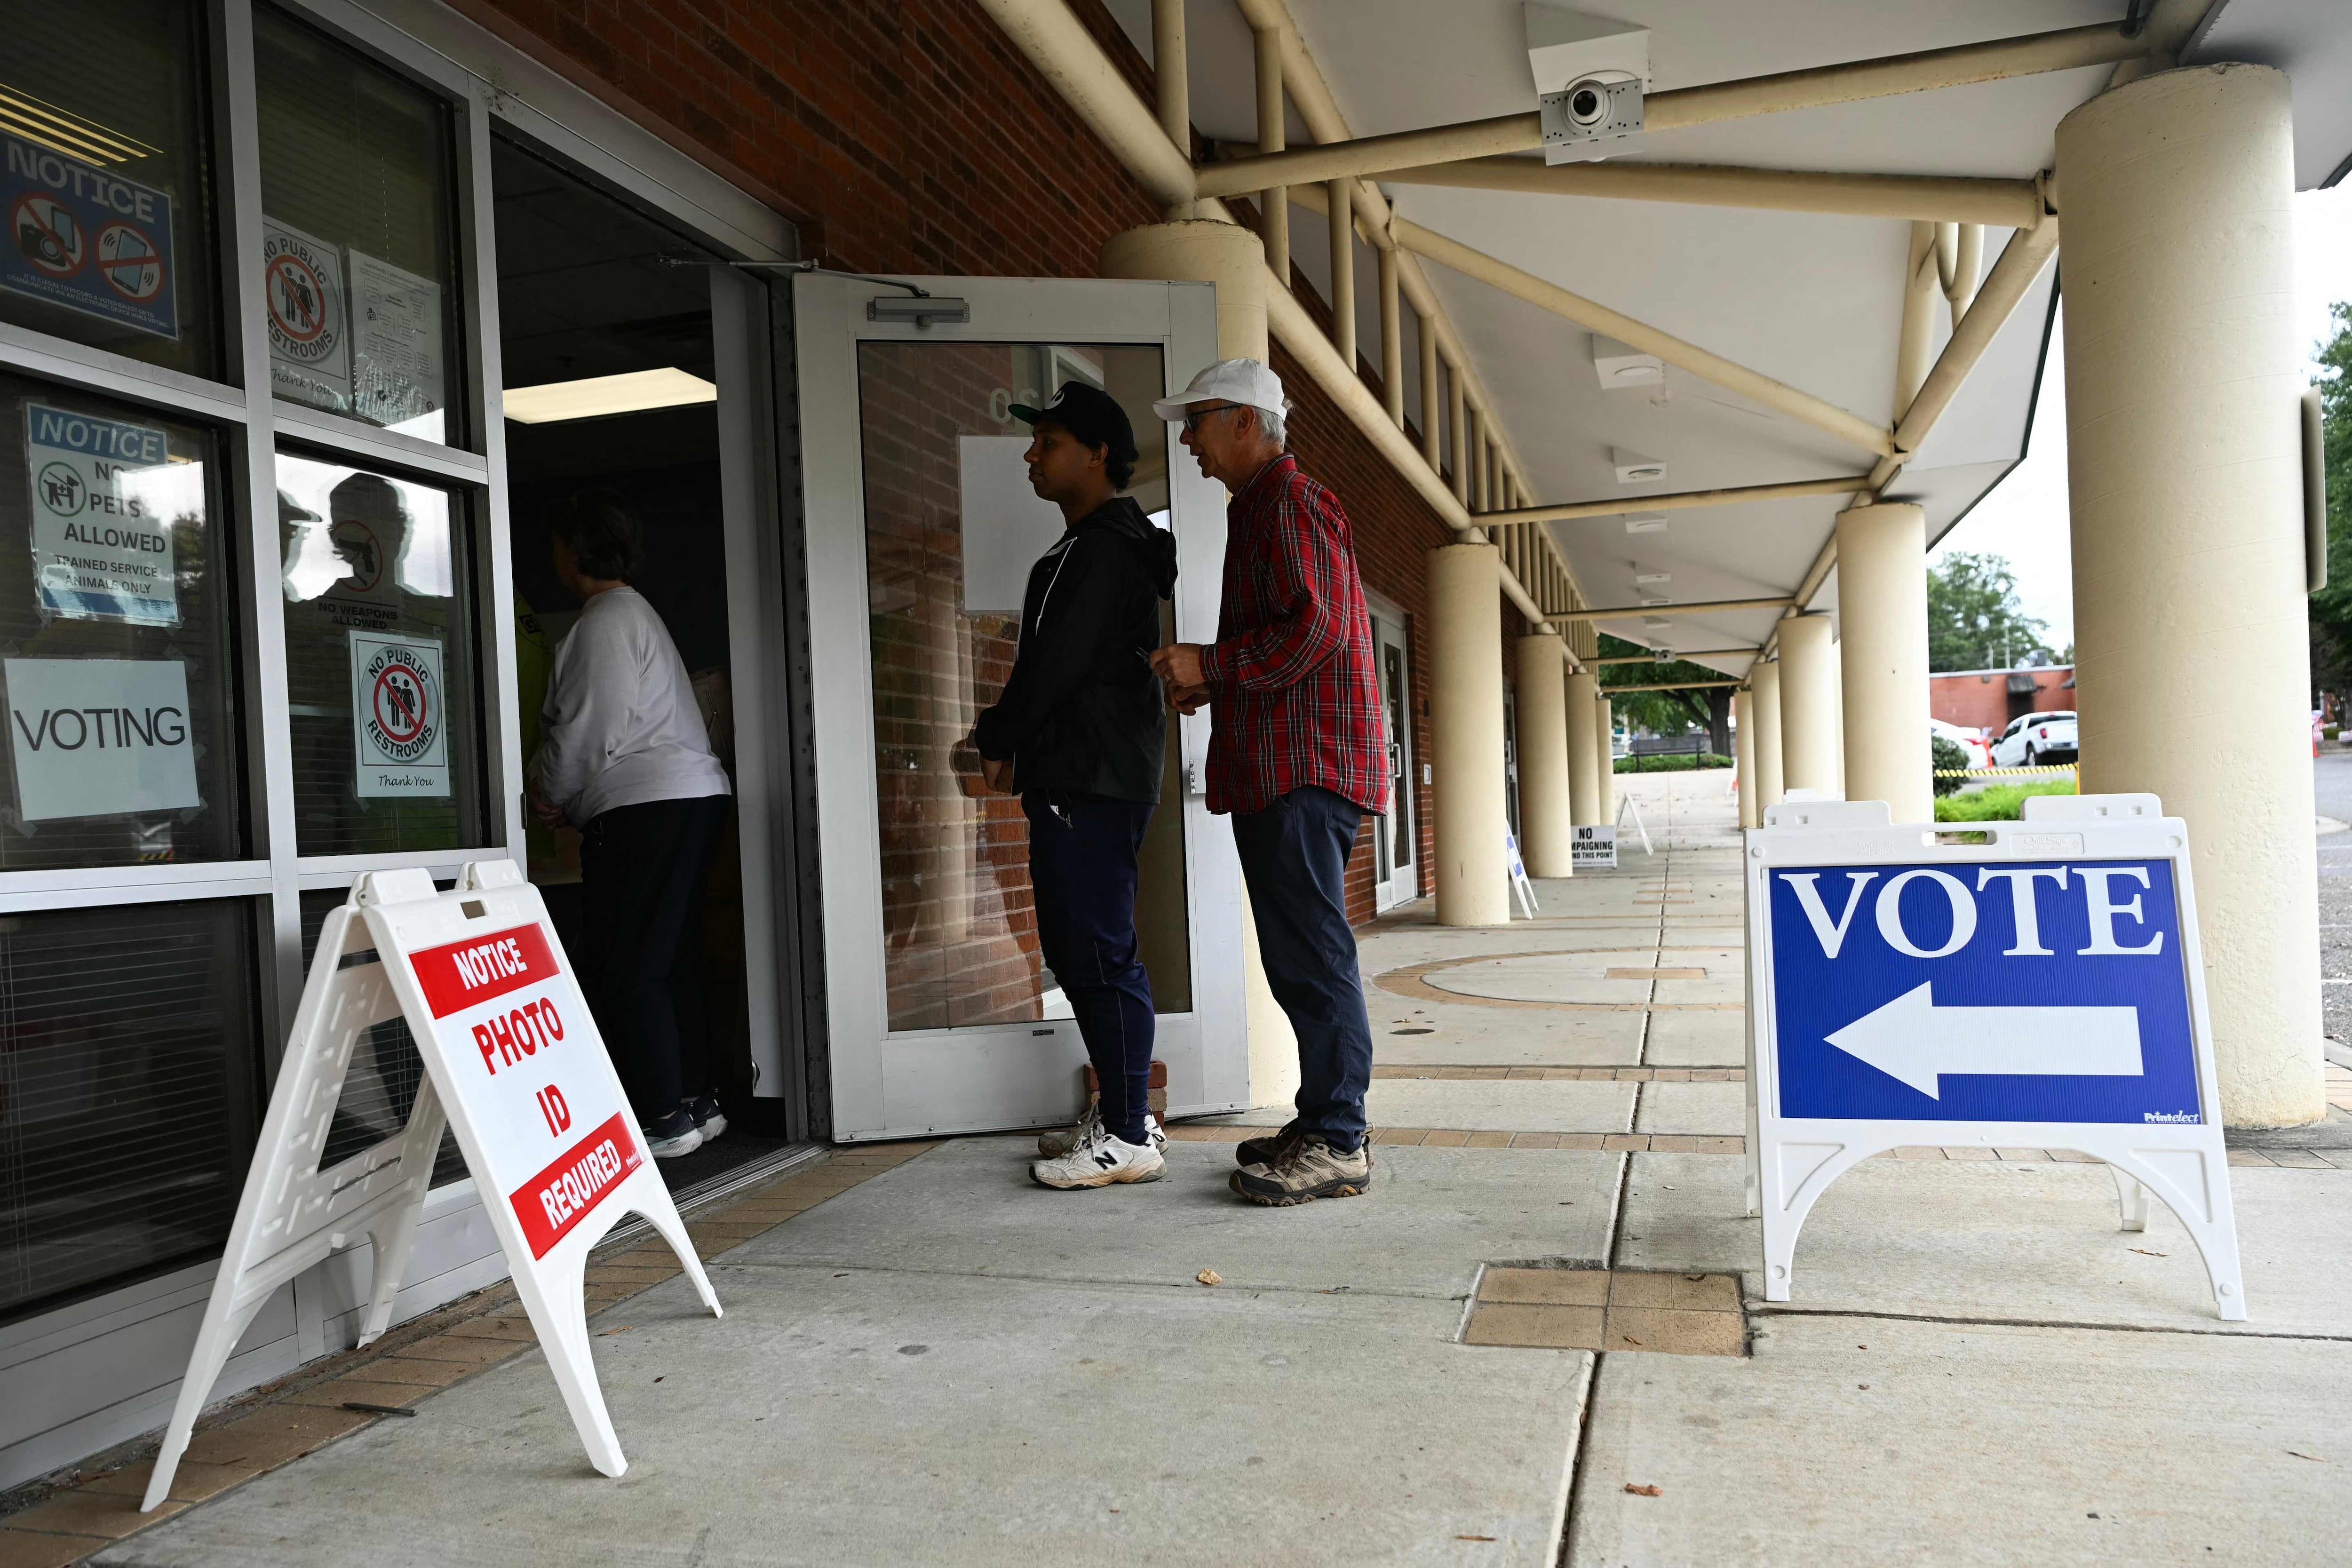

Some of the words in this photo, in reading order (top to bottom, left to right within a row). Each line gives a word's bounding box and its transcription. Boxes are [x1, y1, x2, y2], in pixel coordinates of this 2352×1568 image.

[7, 142, 154, 224] NOTICE
[280, 238, 326, 285] PUBLIC
[7, 274, 54, 293] COMMUNICATE
[76, 295, 110, 310] ELECTRONIC
[111, 306, 130, 317] DEVICE
[131, 311, 147, 322] WHILE
[37, 277, 60, 288] ILLEGAL
[69, 287, 93, 299] RECORD
[98, 296, 118, 306] VOTED
[118, 302, 137, 311] BALLOT
[267, 309, 333, 358] ESTROOMS
[310, 380, 333, 395] You
[40, 414, 159, 462] NOTICE
[90, 493, 140, 518] PETS
[64, 522, 166, 553] ALLOWED
[55, 555, 108, 571] TRAINED
[111, 562, 158, 577] SERVICE
[66, 575, 119, 590] ANIMALS
[121, 581, 151, 594] ONLY
[318, 602, 336, 613] NO
[340, 605, 398, 620] WEAPONS
[331, 615, 388, 629] ALLOWED
[368, 656, 385, 679] NO
[386, 649, 428, 682] PUBLIC
[14, 707, 185, 751] VOTING
[368, 719, 433, 758] RESTROOMS
[378, 774, 413, 787] Thank
[414, 775, 434, 787] You
[1579, 827, 1592, 840] NO
[1858, 847, 1896, 855] AMERICA
[1779, 865, 2164, 959] VOTE
[452, 937, 528, 990] NOTICE
[471, 996, 564, 1076] PHOTO
[535, 1083, 572, 1138] ID
[2144, 1110, 2200, 1122] Printelect
[539, 1138, 622, 1231] REQUIRED
